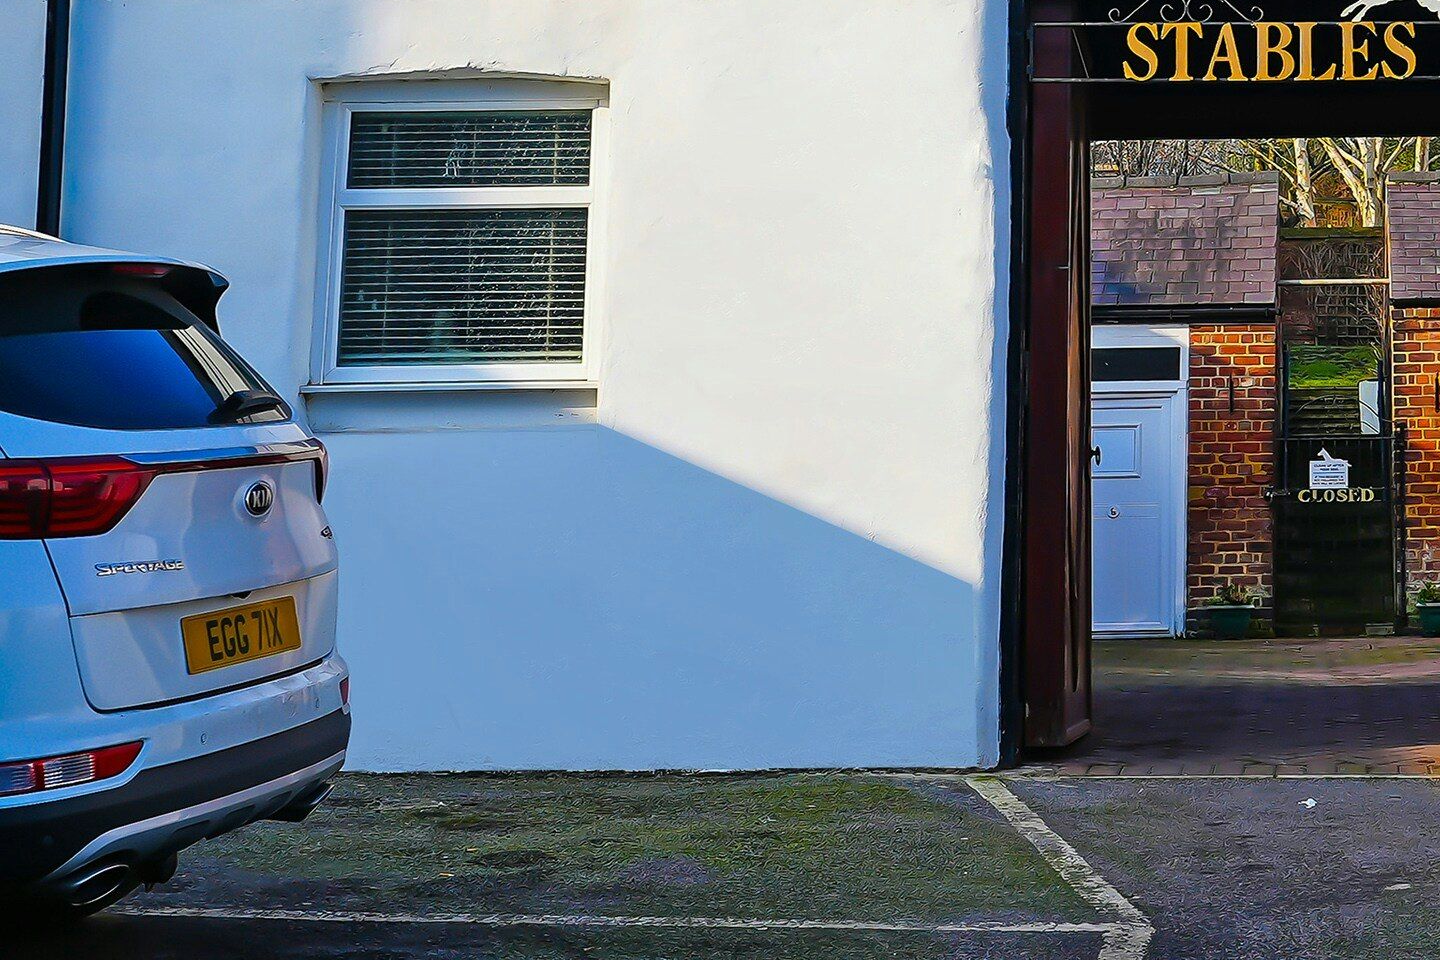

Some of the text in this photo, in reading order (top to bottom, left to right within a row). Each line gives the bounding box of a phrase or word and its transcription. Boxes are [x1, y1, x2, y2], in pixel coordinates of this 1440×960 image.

[1122, 21, 1417, 82] STABLES
[252, 489, 271, 507] KIA
[1298, 489, 1375, 502] CLOSED
[205, 614, 250, 661] EGG
